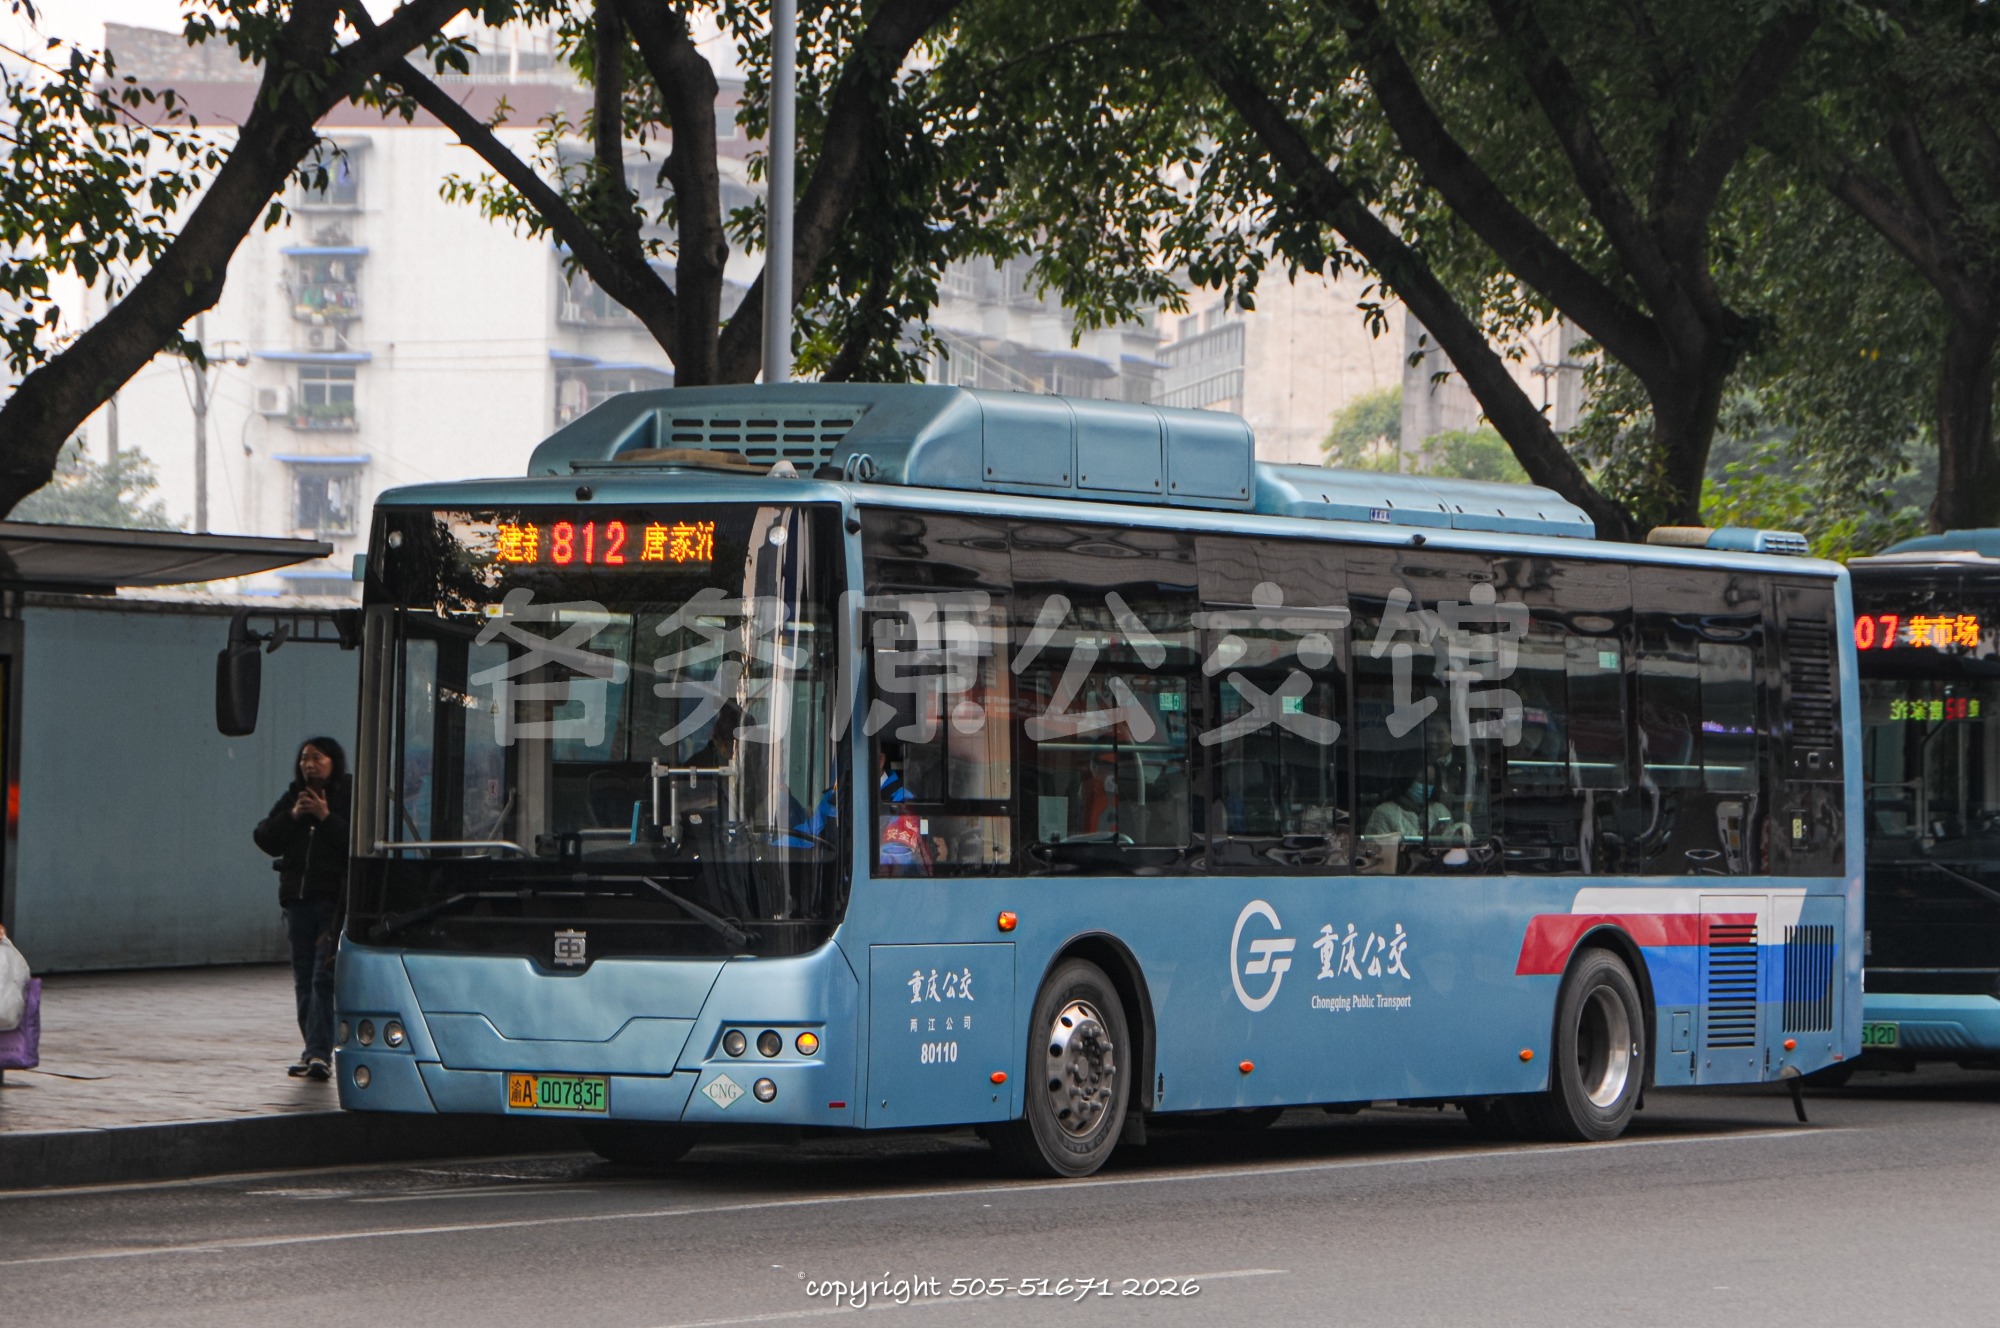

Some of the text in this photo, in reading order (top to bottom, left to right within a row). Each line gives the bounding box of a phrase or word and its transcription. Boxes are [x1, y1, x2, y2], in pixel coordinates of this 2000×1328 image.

[552, 520, 626, 565] 812
[1312, 923, 1411, 980] 重庆公交
[907, 968, 974, 1003] 重庆公交
[1311, 994, 1412, 1012] Chongqing Public Transport
[910, 1016, 971, 1032] 两江公司
[920, 1042, 958, 1064] 80110
[709, 1082, 738, 1099] CNG
